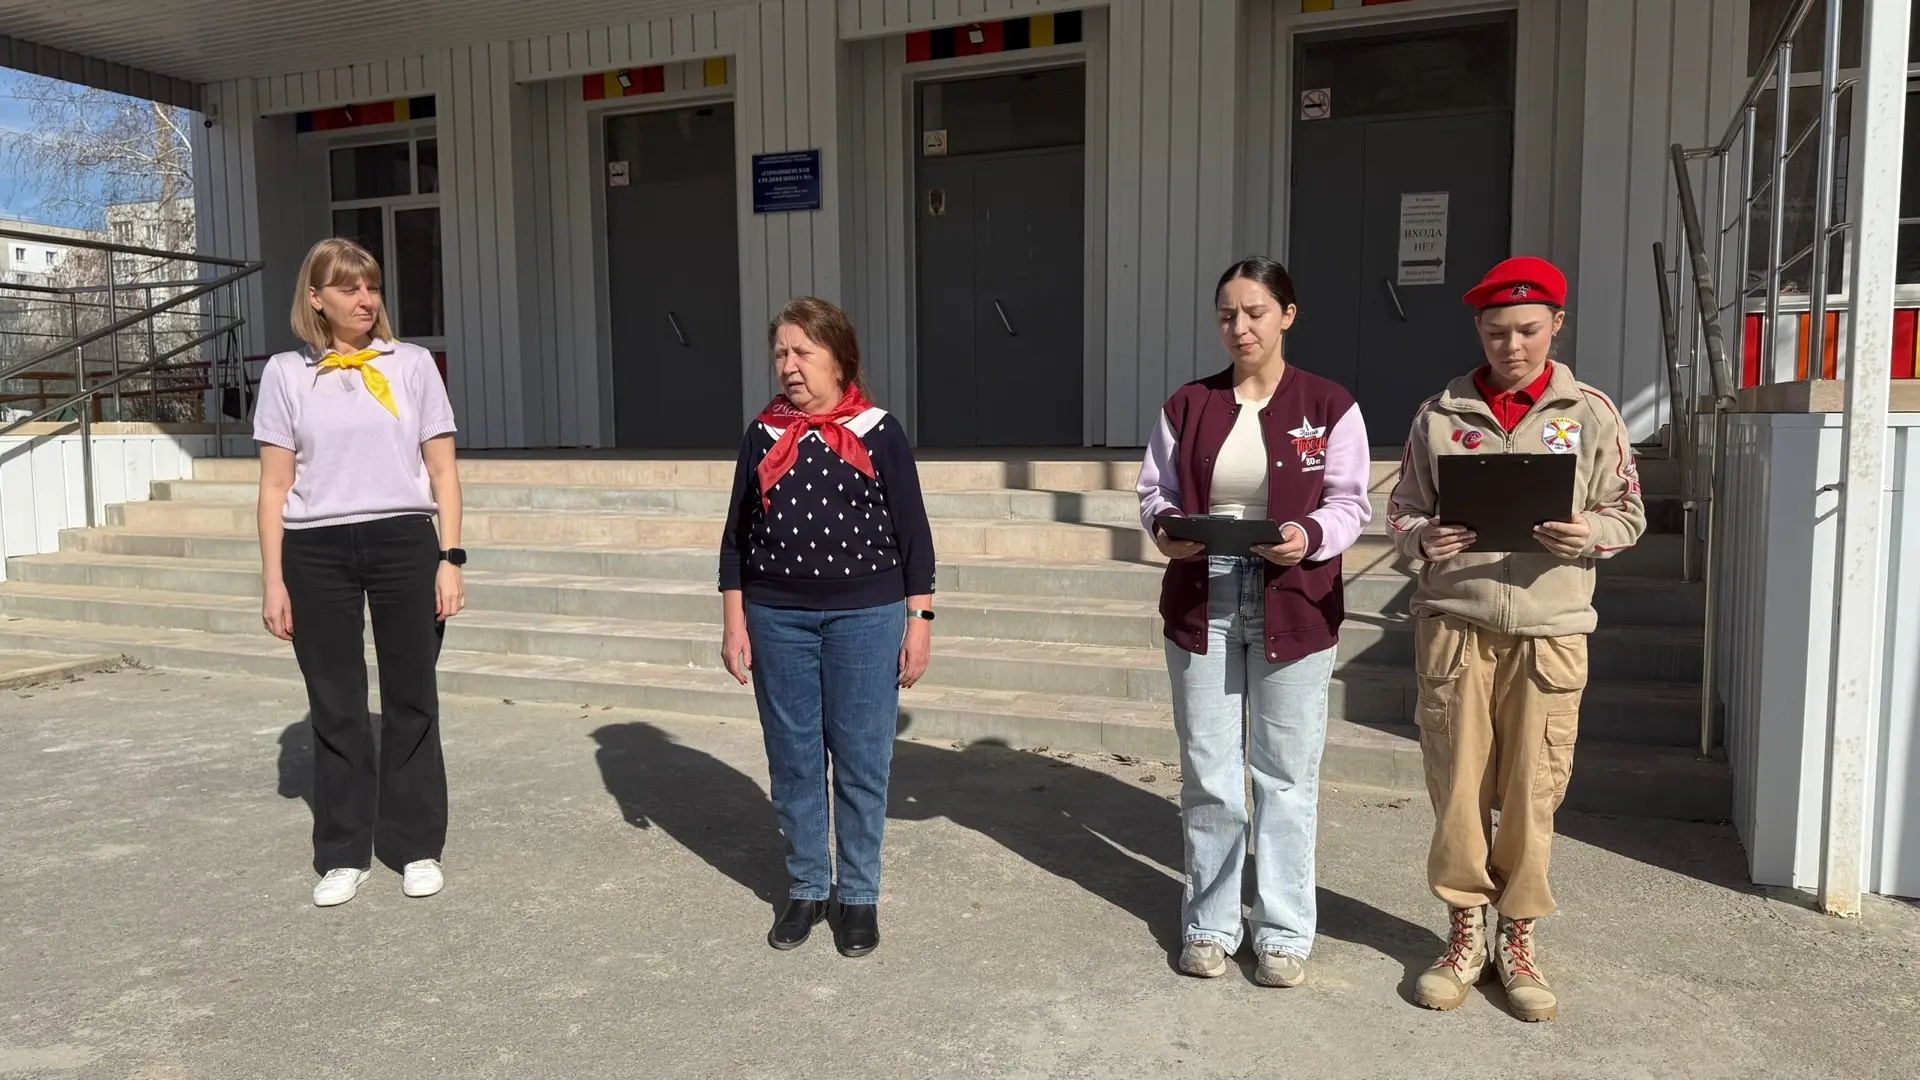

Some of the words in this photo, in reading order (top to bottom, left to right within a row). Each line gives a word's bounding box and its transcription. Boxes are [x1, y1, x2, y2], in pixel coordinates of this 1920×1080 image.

[1404, 229, 1442, 238] ВХОДА
[1414, 242, 1436, 251] НЕТ
[1306, 457, 1315, 466] 80
